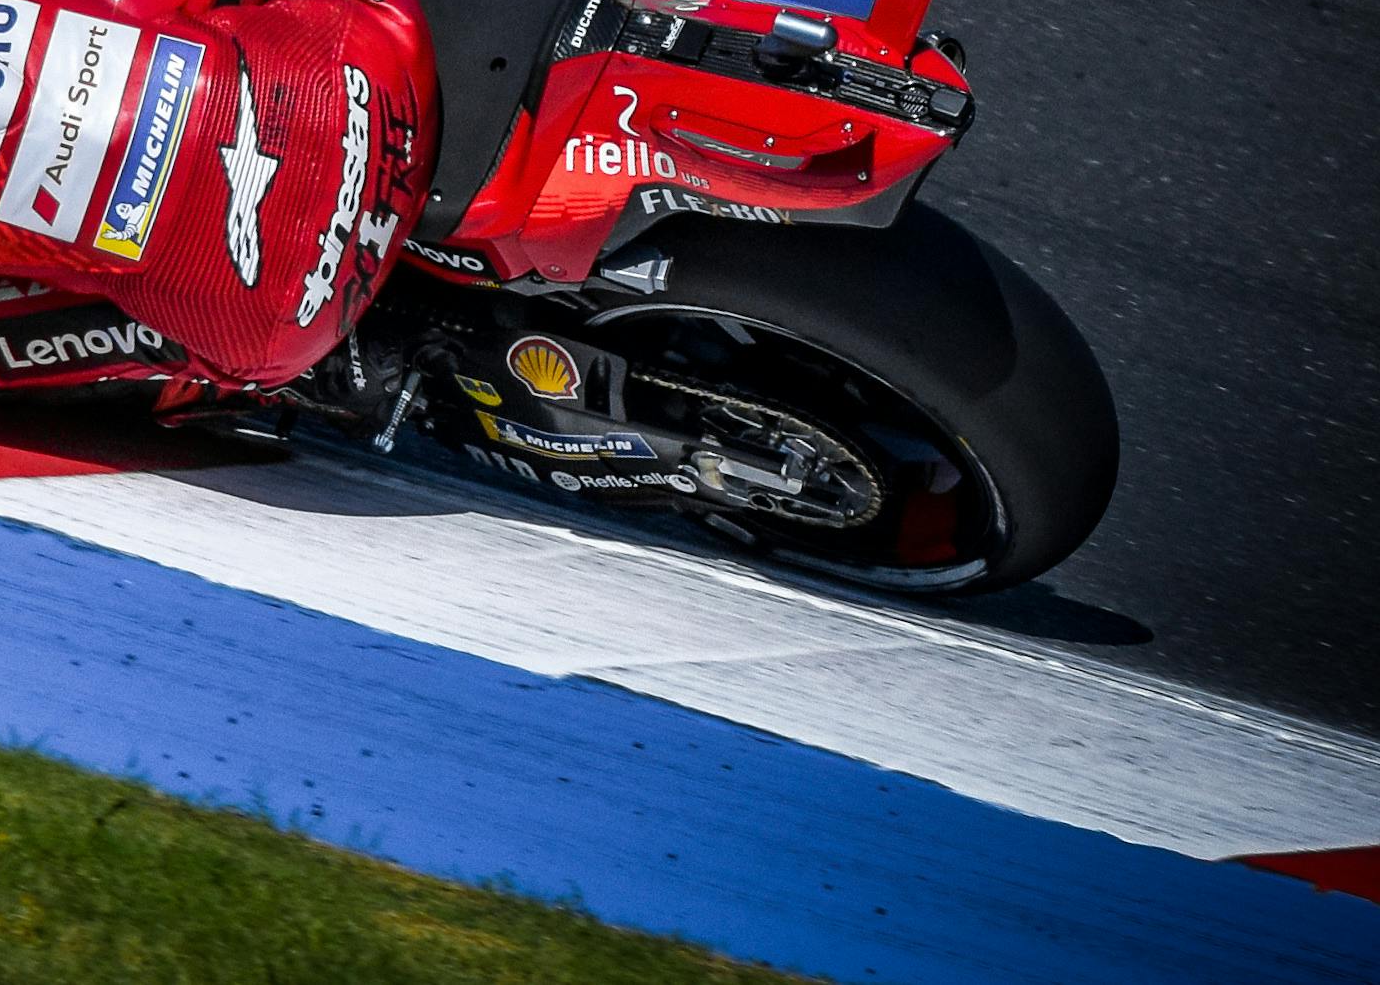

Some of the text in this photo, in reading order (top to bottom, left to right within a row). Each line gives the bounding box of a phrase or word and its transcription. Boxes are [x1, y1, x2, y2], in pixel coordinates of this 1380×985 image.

[45, 25, 108, 186] Audi Sport
[131, 53, 186, 198] MICHELIN
[296, 65, 369, 327] alpinestars
[566, 134, 677, 178] riello
[681, 172, 710, 190] ups
[359, 211, 399, 259] 1
[403, 238, 484, 272] novo
